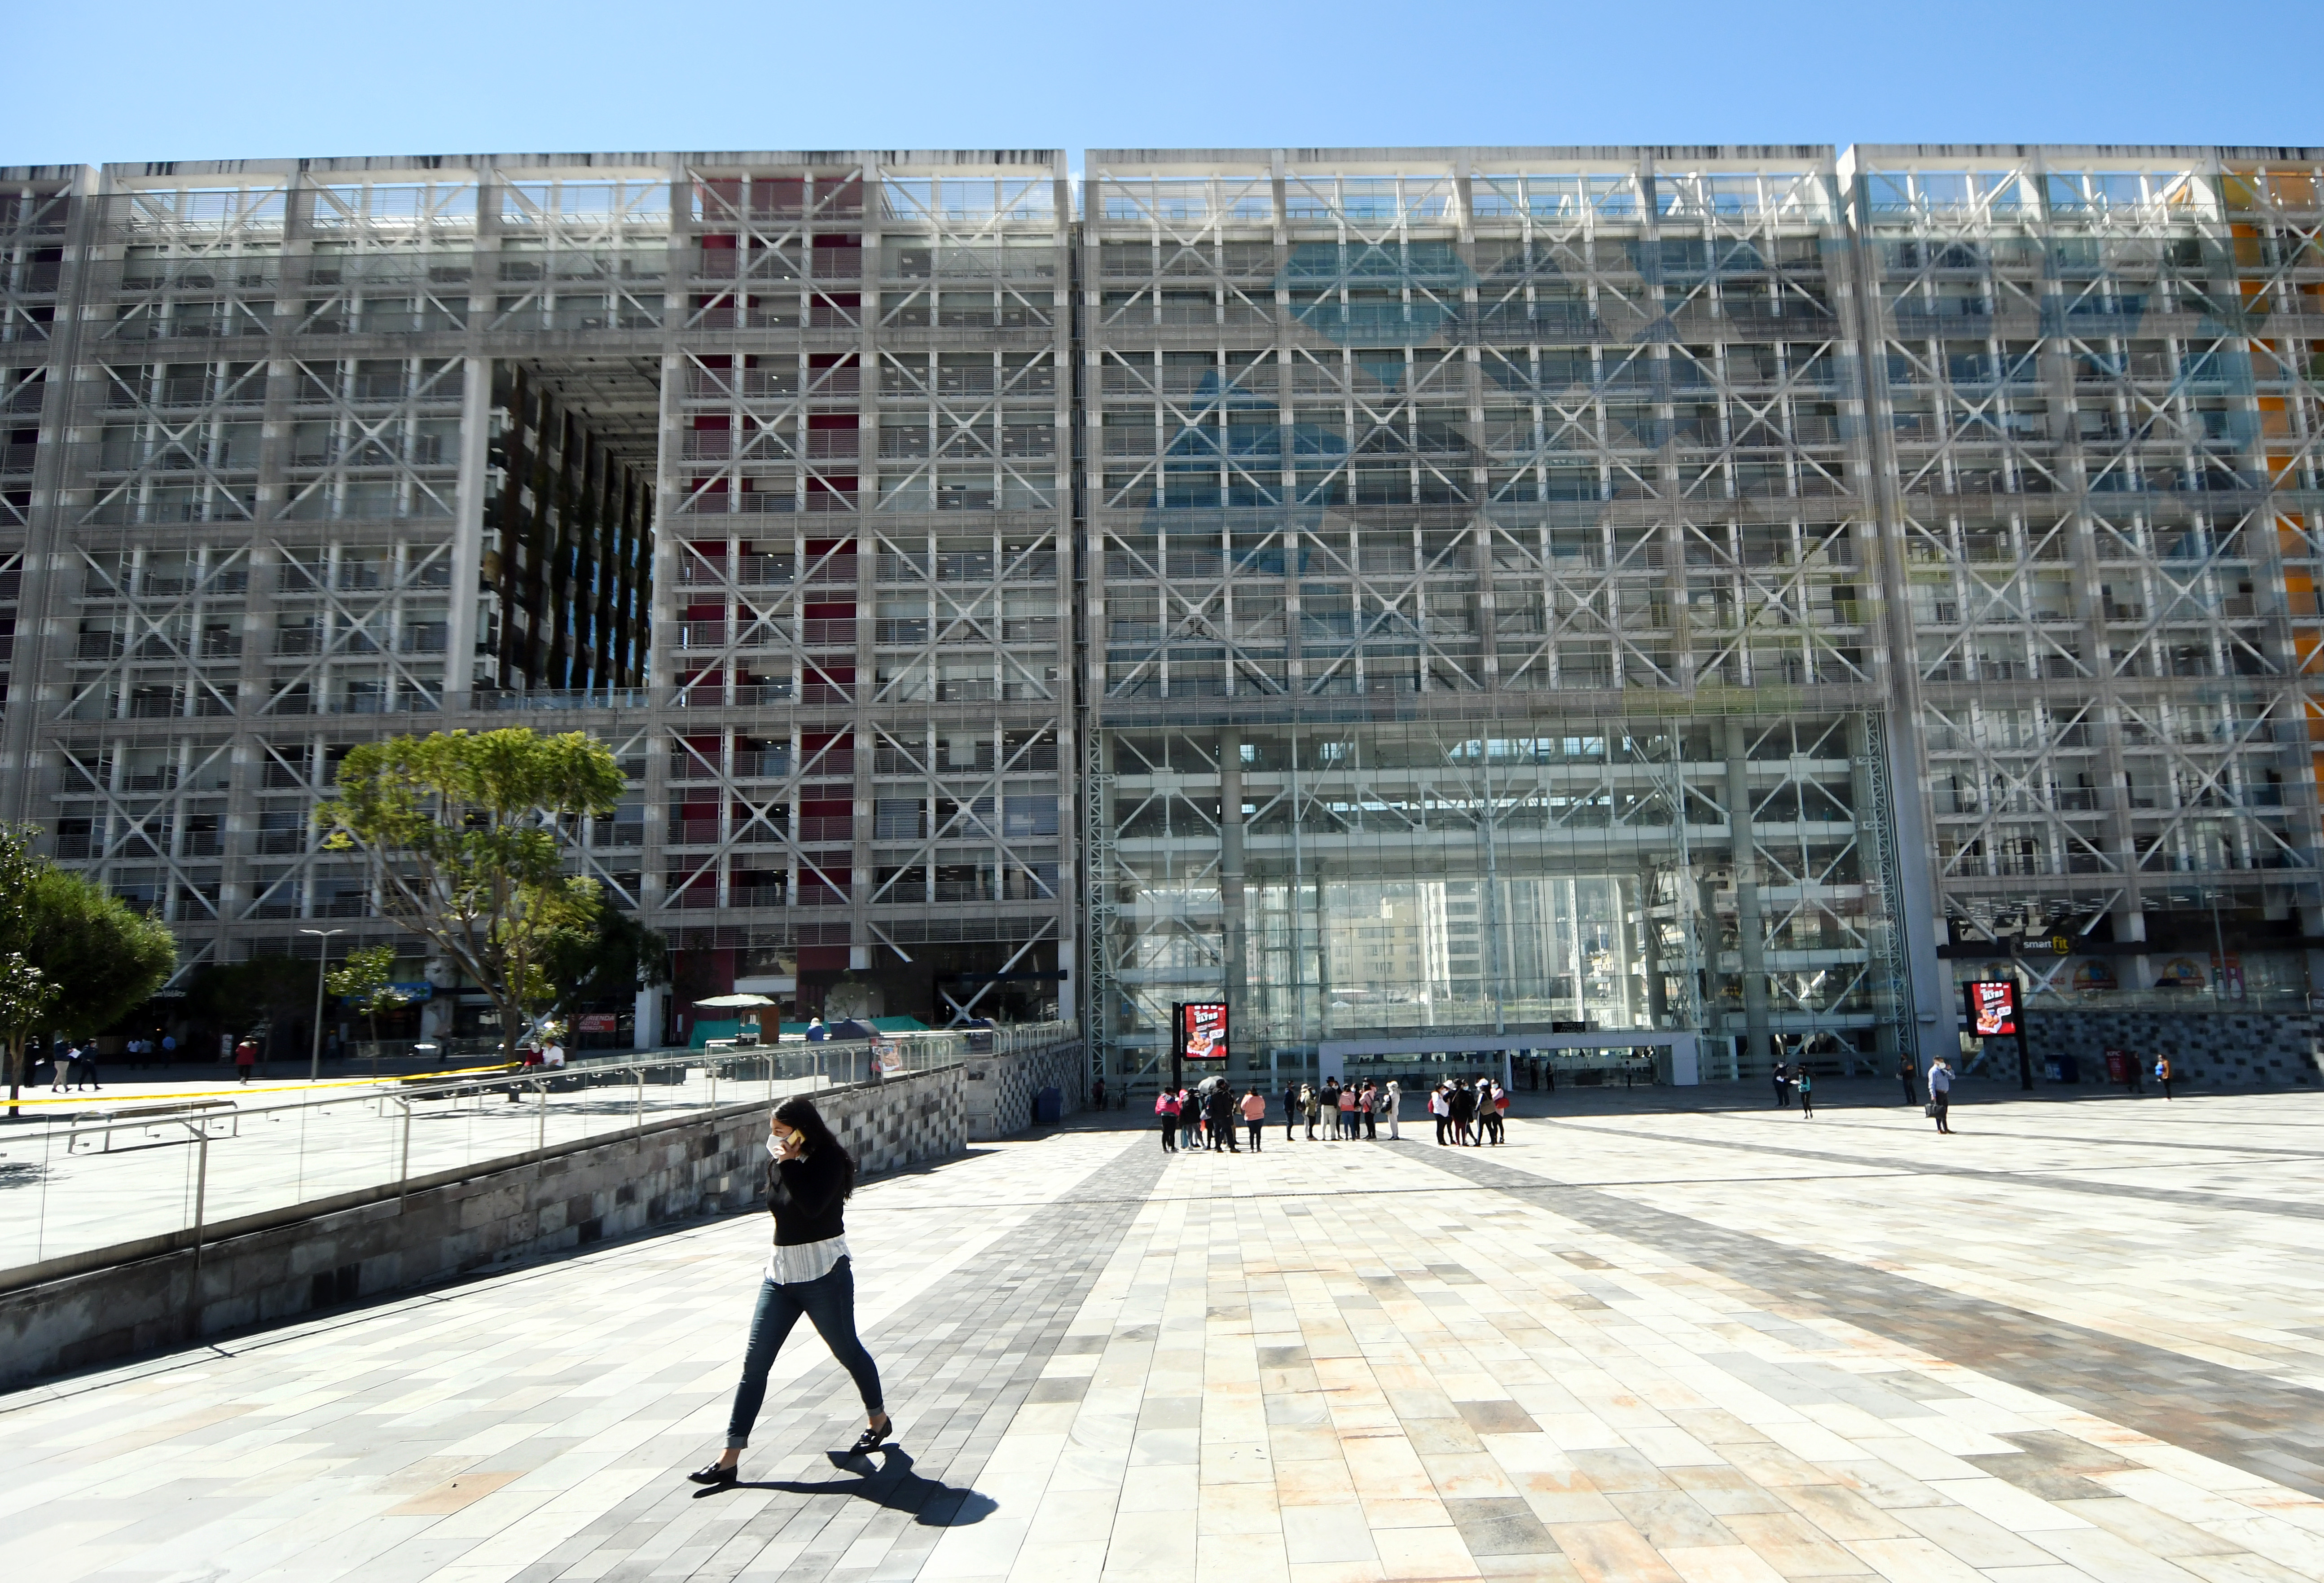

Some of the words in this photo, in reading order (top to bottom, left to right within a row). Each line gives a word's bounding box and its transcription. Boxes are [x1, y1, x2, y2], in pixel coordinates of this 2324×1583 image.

[2024, 941, 2052, 949] smart
[2052, 936, 2069, 949] fit
[1417, 1025, 1480, 1036] INFORMACIÓN
